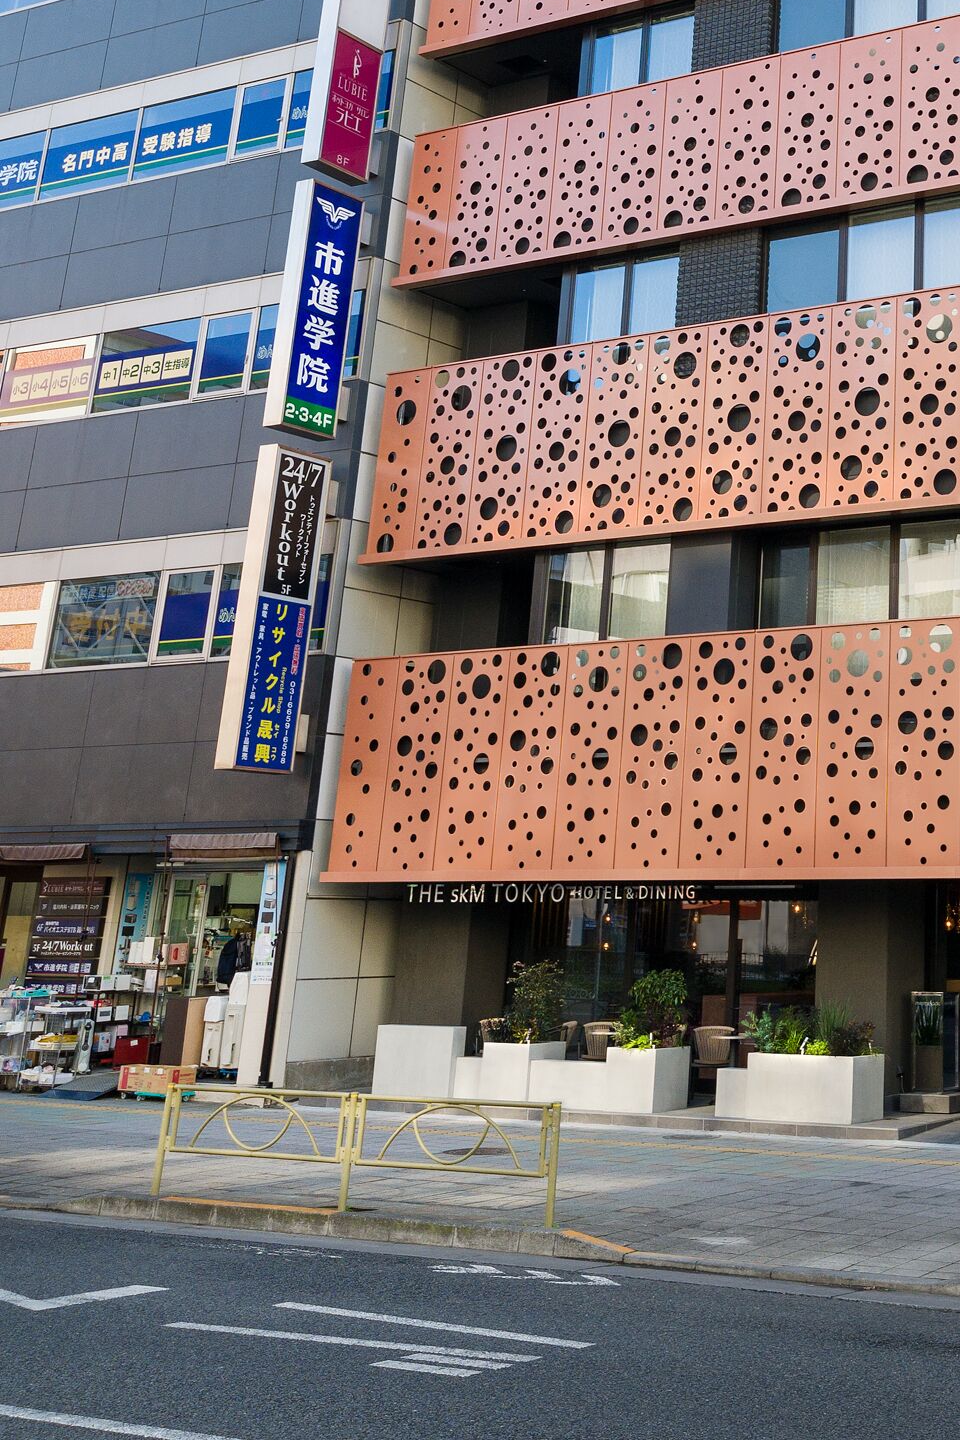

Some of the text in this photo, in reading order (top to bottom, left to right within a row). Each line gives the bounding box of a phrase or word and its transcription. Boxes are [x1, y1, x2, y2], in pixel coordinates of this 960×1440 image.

[337, 75, 368, 102] LUBIE
[335, 106, 363, 134] ラビエ
[61, 141, 129, 174] 名門中高
[141, 122, 213, 157] 受験指導
[336, 154, 350, 166] 8F
[295, 241, 346, 394] 市進学院
[281, 456, 323, 488] 24/7
[277, 479, 305, 582] Workout
[295, 513, 307, 558] ワークアウト
[280, 584, 292, 596] 5F
[407, 884, 445, 903] THE
[492, 883, 566, 903] TOKYO
[570, 885, 622, 900] HOTEL
[639, 885, 696, 900] DINING
